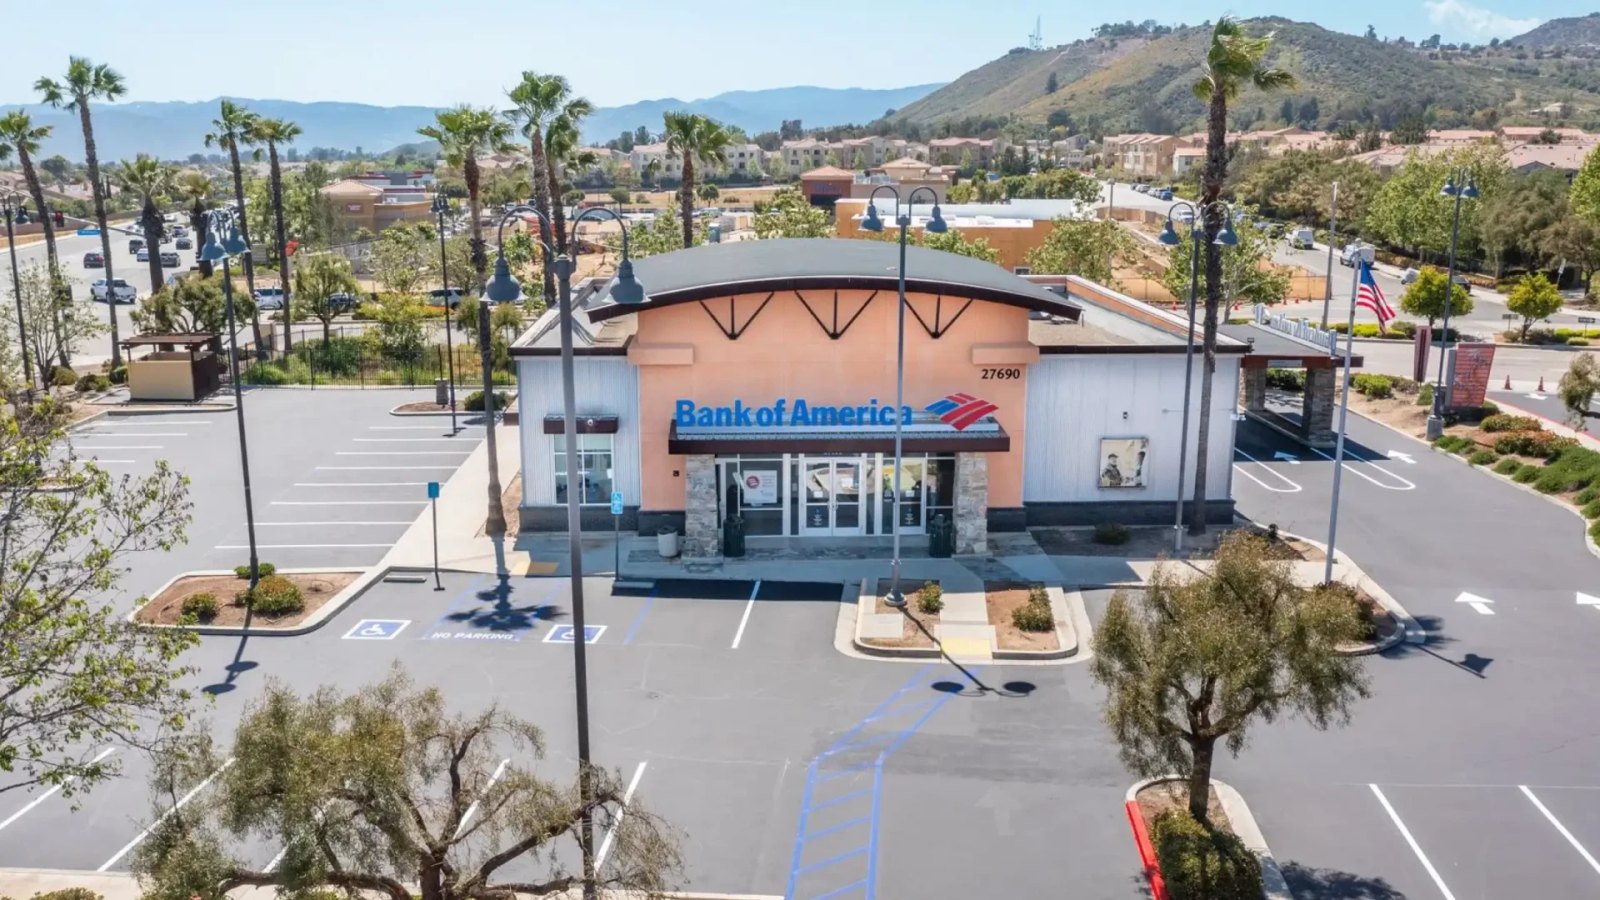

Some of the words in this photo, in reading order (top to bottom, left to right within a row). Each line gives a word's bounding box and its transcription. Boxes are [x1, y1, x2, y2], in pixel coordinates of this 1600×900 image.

[981, 368, 1020, 379] 27690
[676, 399, 752, 427] Bank
[756, 398, 786, 427] of
[789, 398, 912, 426] America
[454, 632, 514, 640] PARKING
